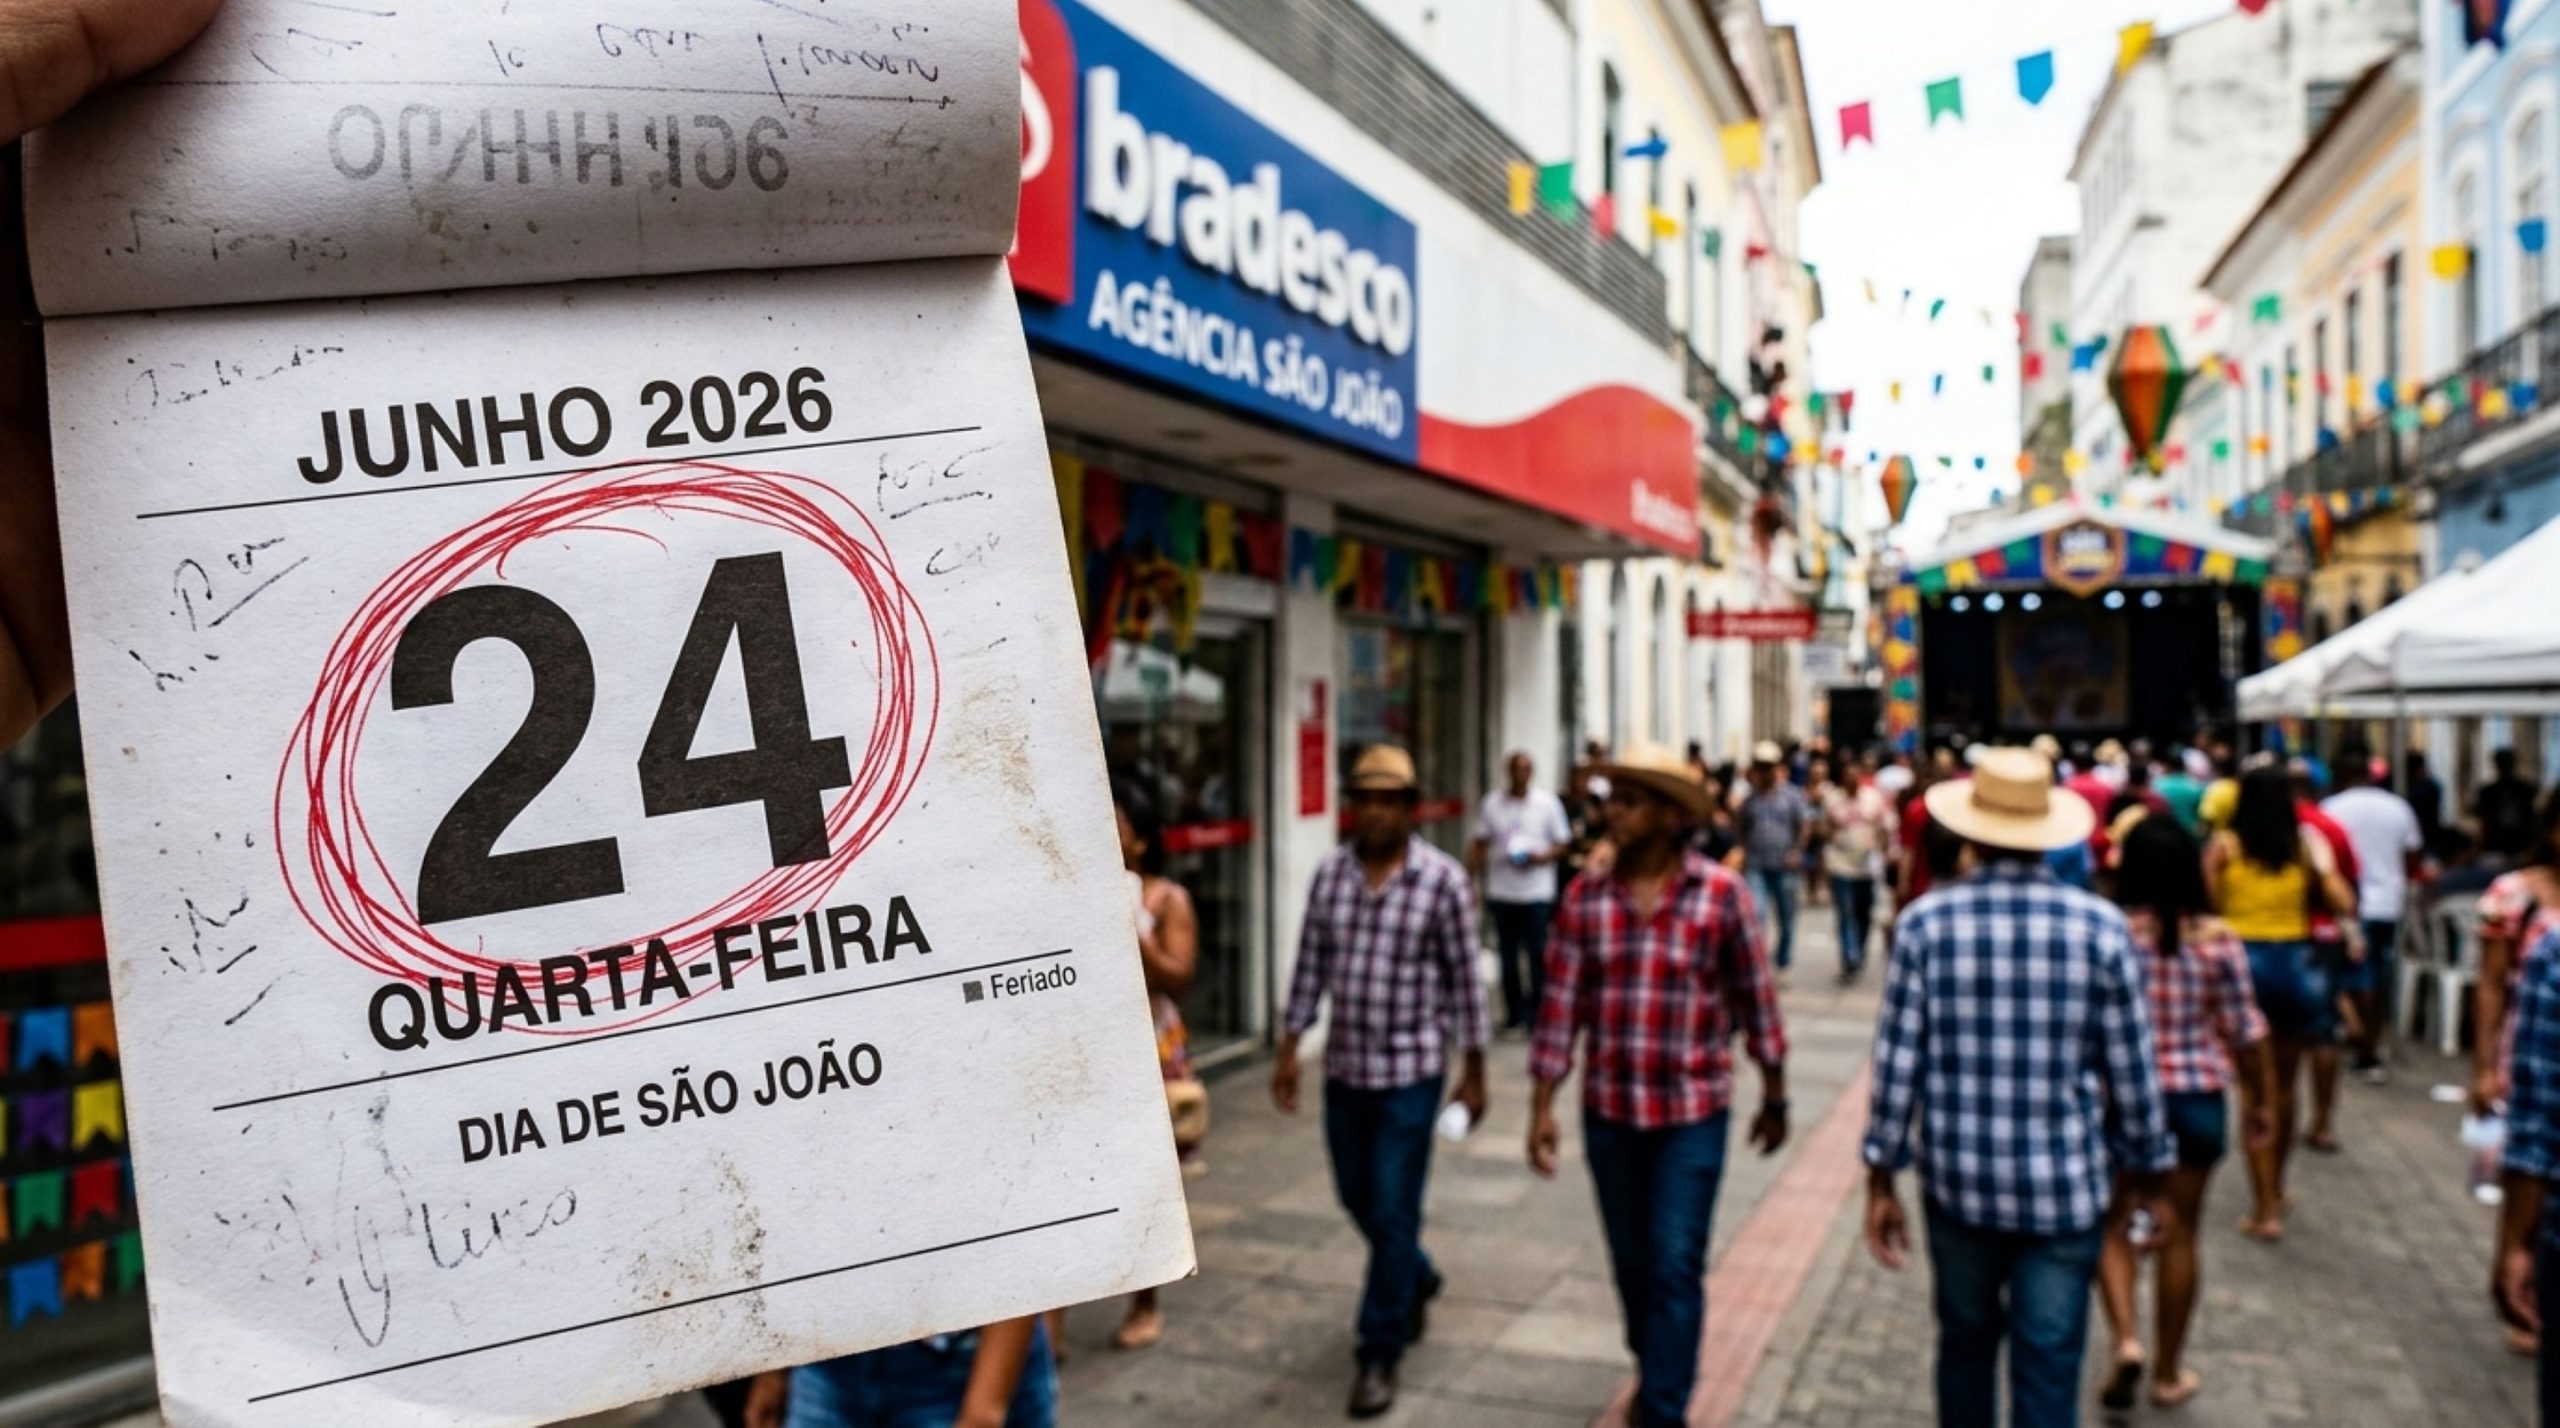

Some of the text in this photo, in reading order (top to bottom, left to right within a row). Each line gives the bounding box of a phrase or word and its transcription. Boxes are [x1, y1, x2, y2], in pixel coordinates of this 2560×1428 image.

[1085, 64, 1412, 355] bradesco
[1089, 269, 1260, 388] AGÊNCIA
[1263, 334, 1329, 411] SÃO
[298, 367, 832, 484] JUNHO 2026
[390, 552, 853, 927] 24
[368, 895, 932, 1051] QUARTA-FEIRA
[990, 963, 1078, 999] Feriado
[459, 1038, 883, 1163] DIA DE SÃO JOÃO
